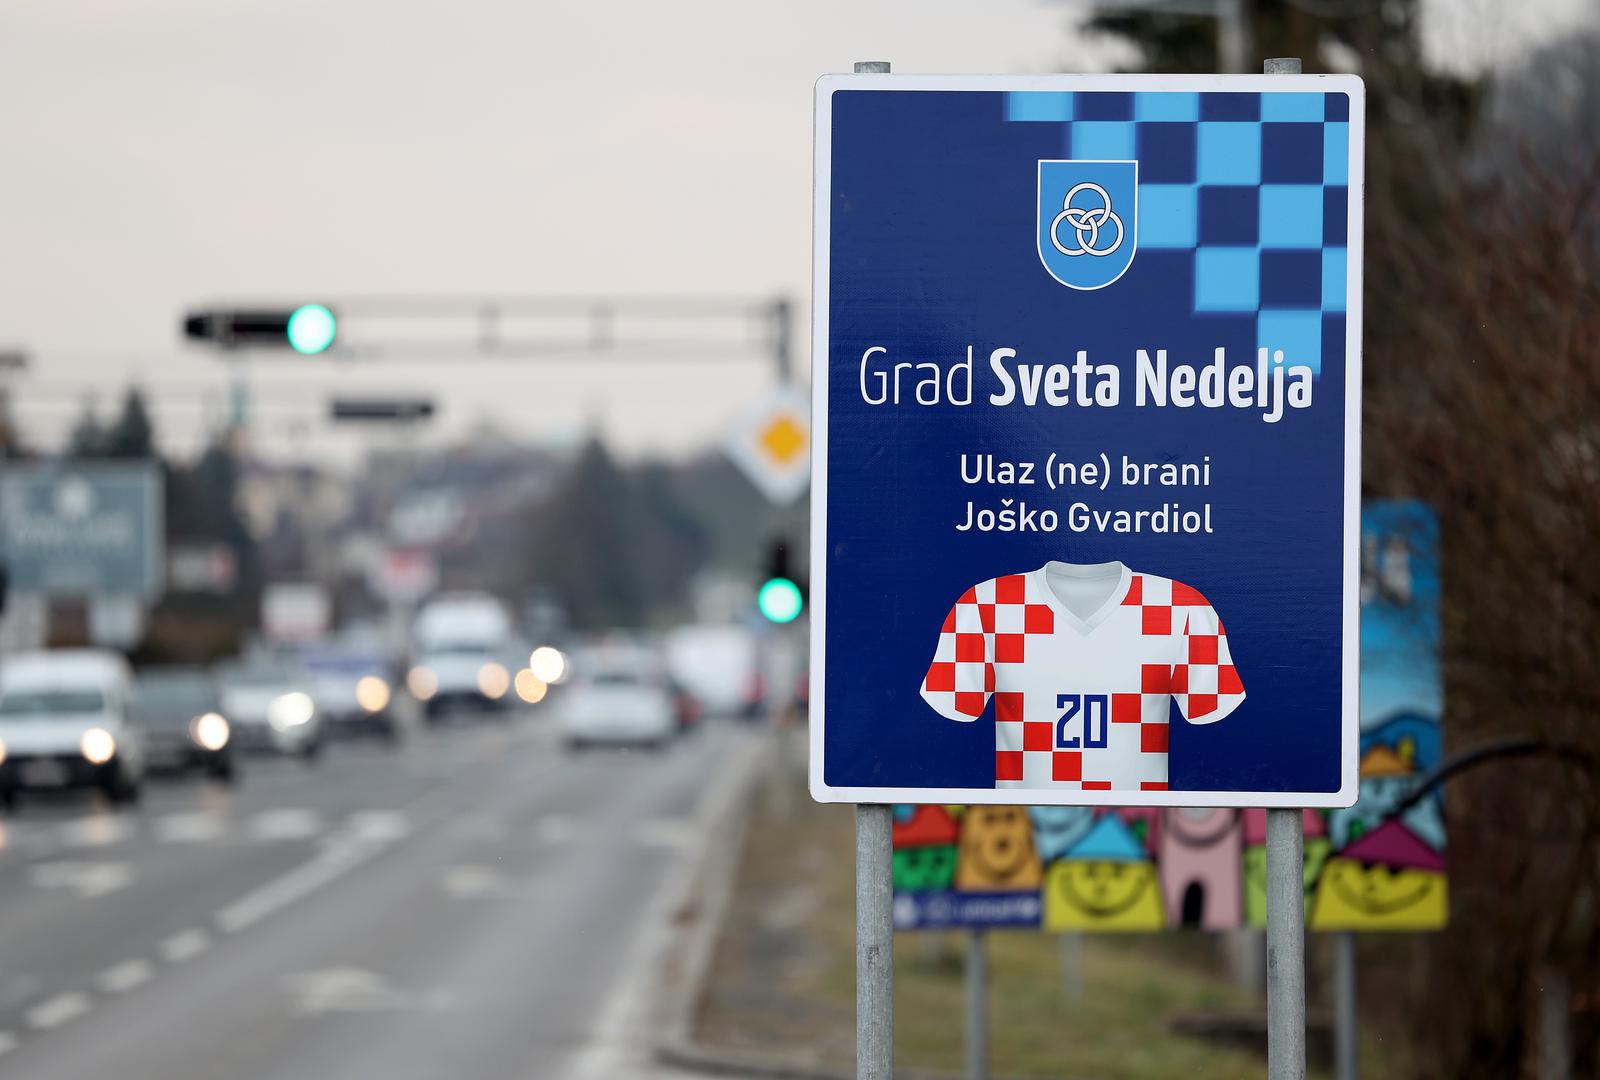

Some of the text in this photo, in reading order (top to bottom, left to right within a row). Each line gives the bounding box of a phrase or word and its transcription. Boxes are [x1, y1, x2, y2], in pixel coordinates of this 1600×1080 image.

[860, 345, 1313, 423] Grad Sveta Nedelja
[961, 452, 1210, 491] Ulaz (ne) brani
[955, 498, 1213, 533] Joško Gvardiol
[1056, 693, 1109, 749] 20
